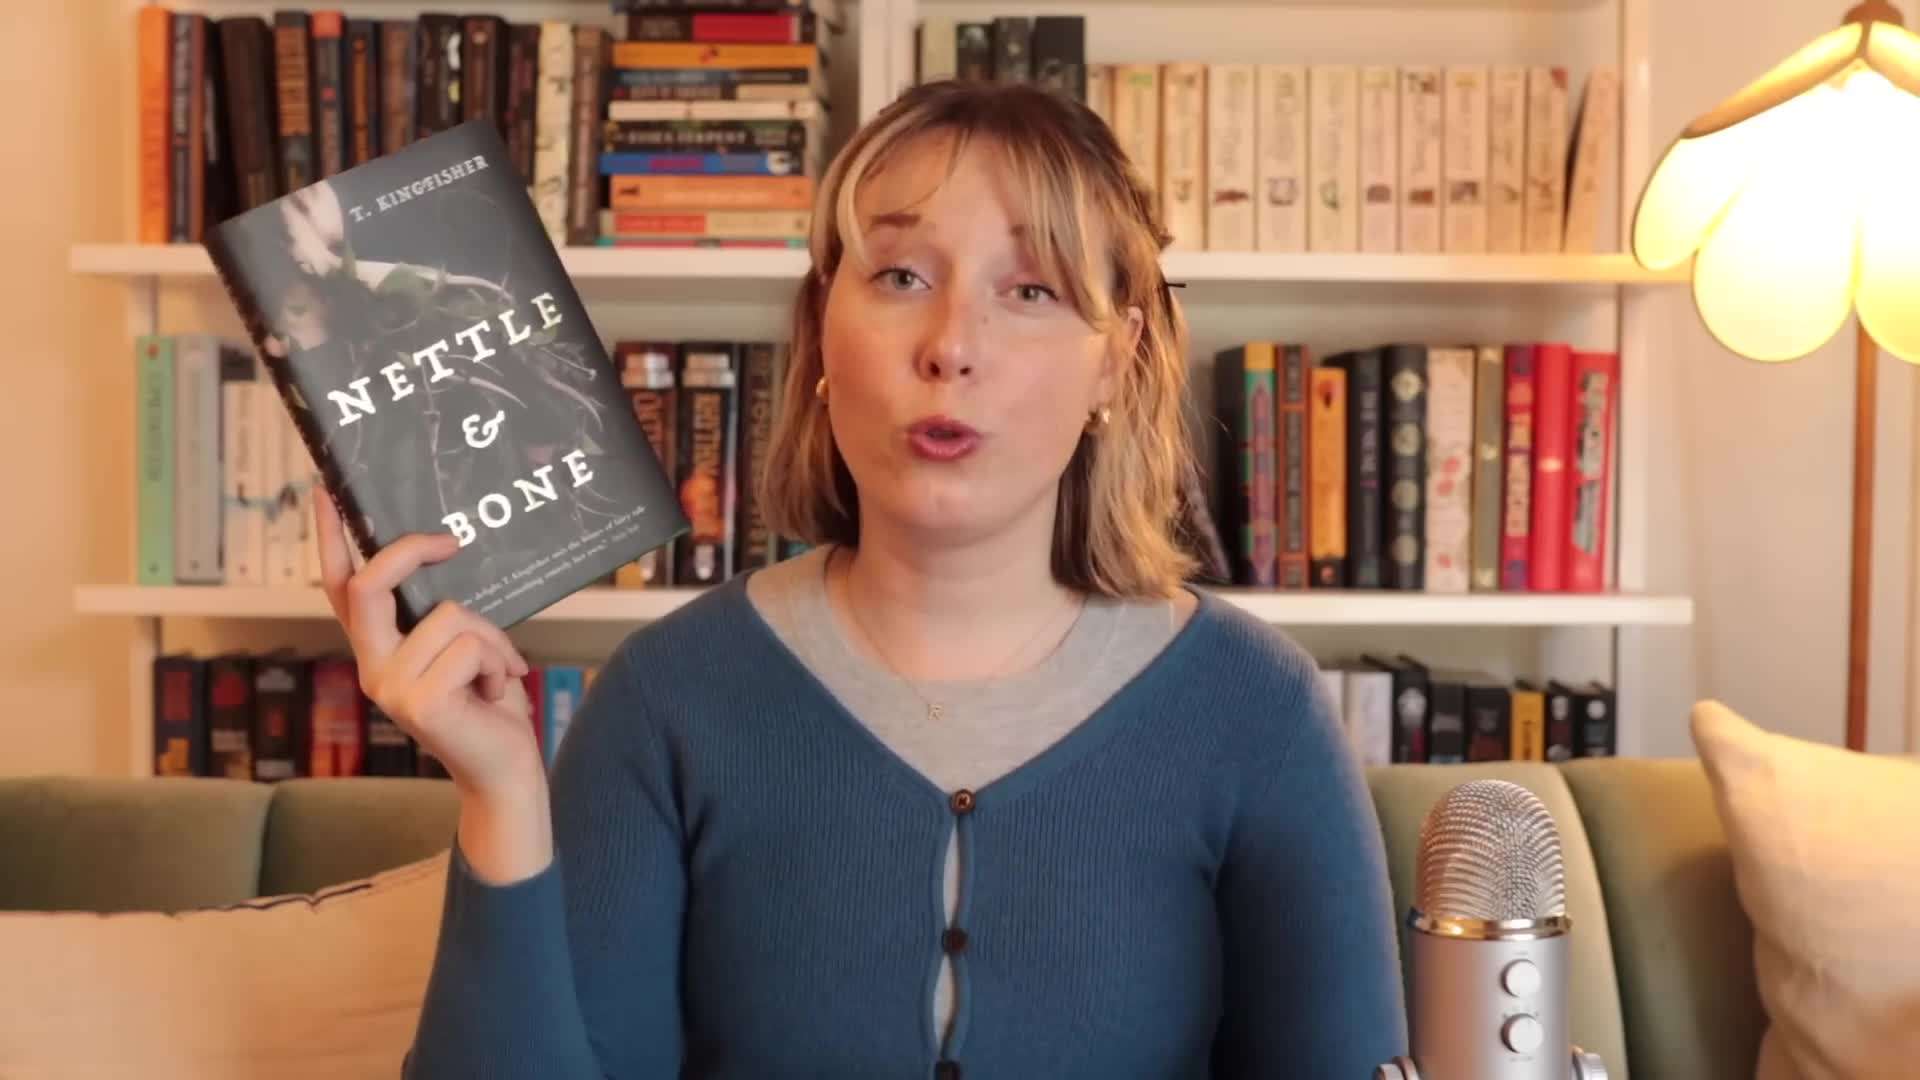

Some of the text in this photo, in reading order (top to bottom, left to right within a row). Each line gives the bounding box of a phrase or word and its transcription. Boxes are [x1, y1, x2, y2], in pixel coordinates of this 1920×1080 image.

[350, 155, 488, 222] T. KINGFISHER
[327, 292, 562, 426] NETTLE
[463, 409, 506, 447] &
[442, 450, 595, 547] BONE
